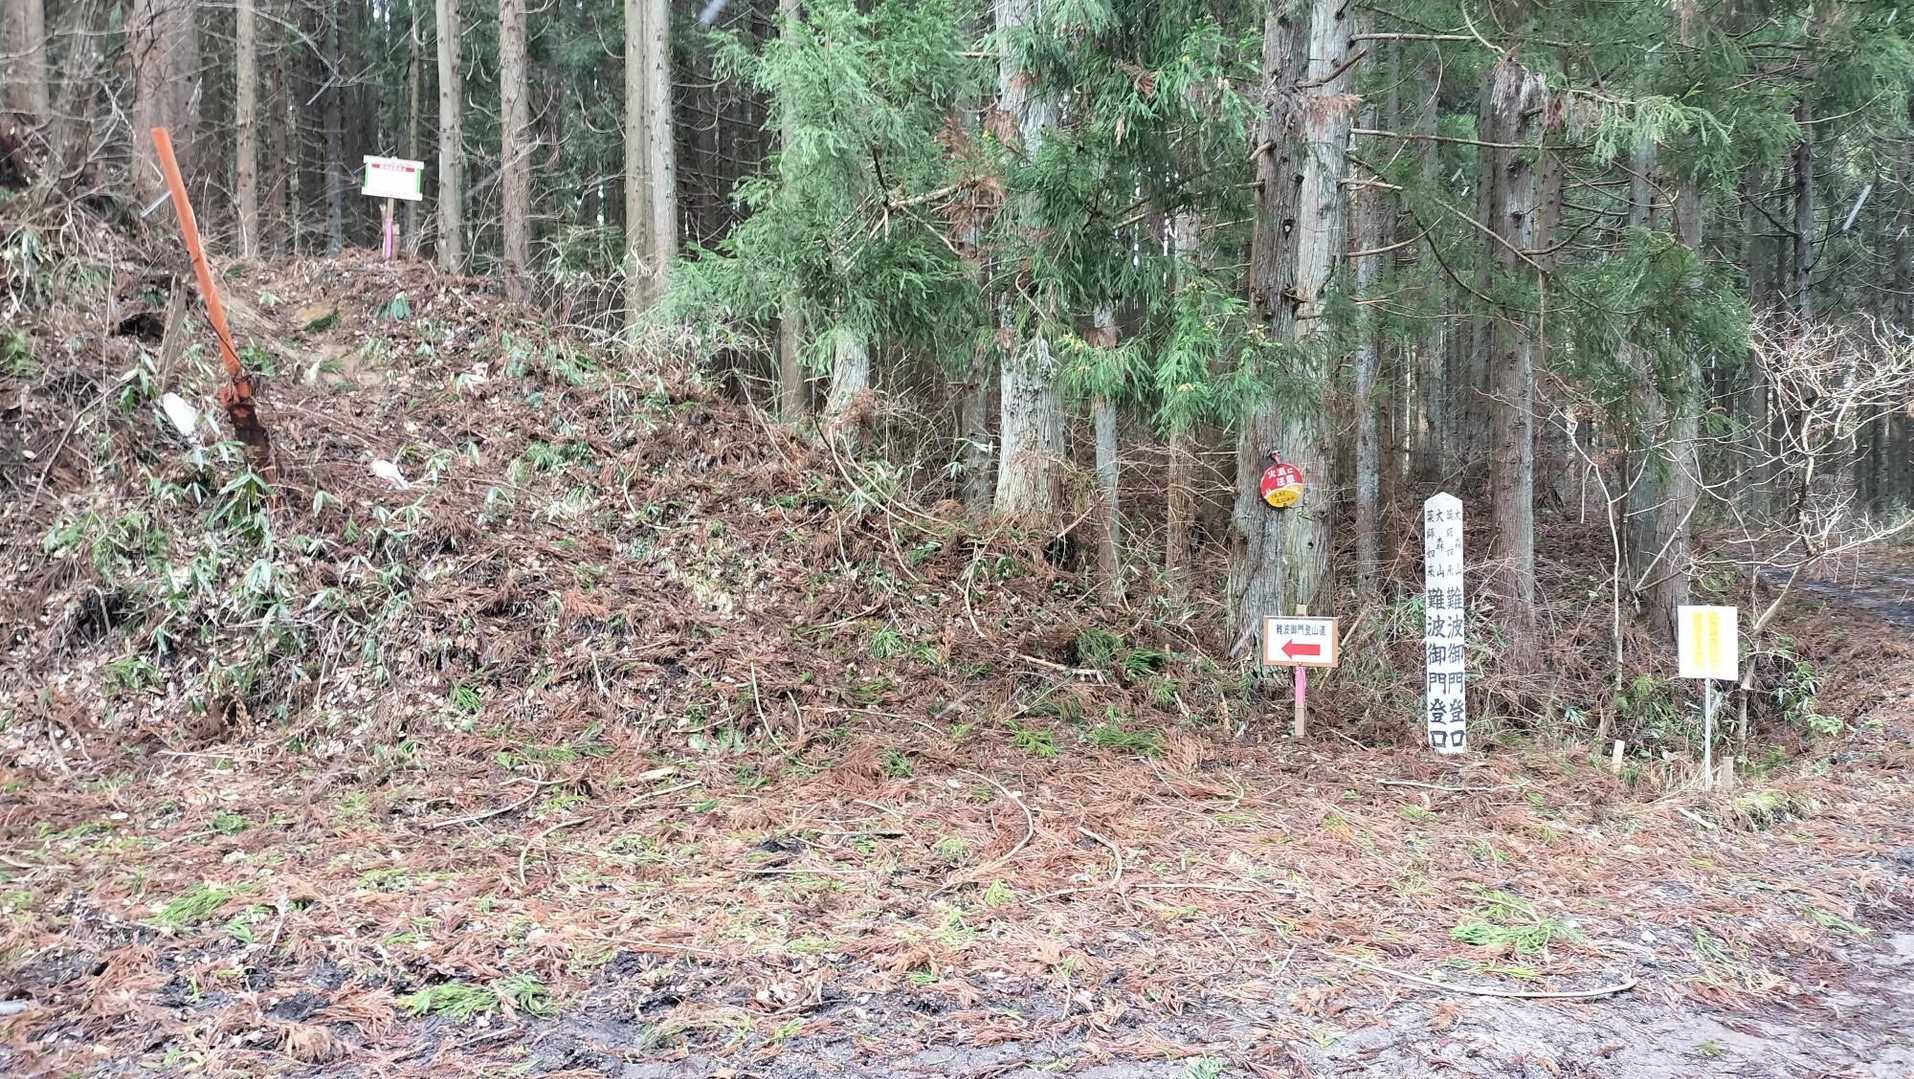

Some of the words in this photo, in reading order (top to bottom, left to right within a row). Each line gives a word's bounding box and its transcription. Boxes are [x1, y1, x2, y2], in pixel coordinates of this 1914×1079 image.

[1436, 508, 1445, 578] 大森山
[1427, 587, 1448, 748] 難波御門登口
[1447, 586, 1465, 747] 難波御門登口
